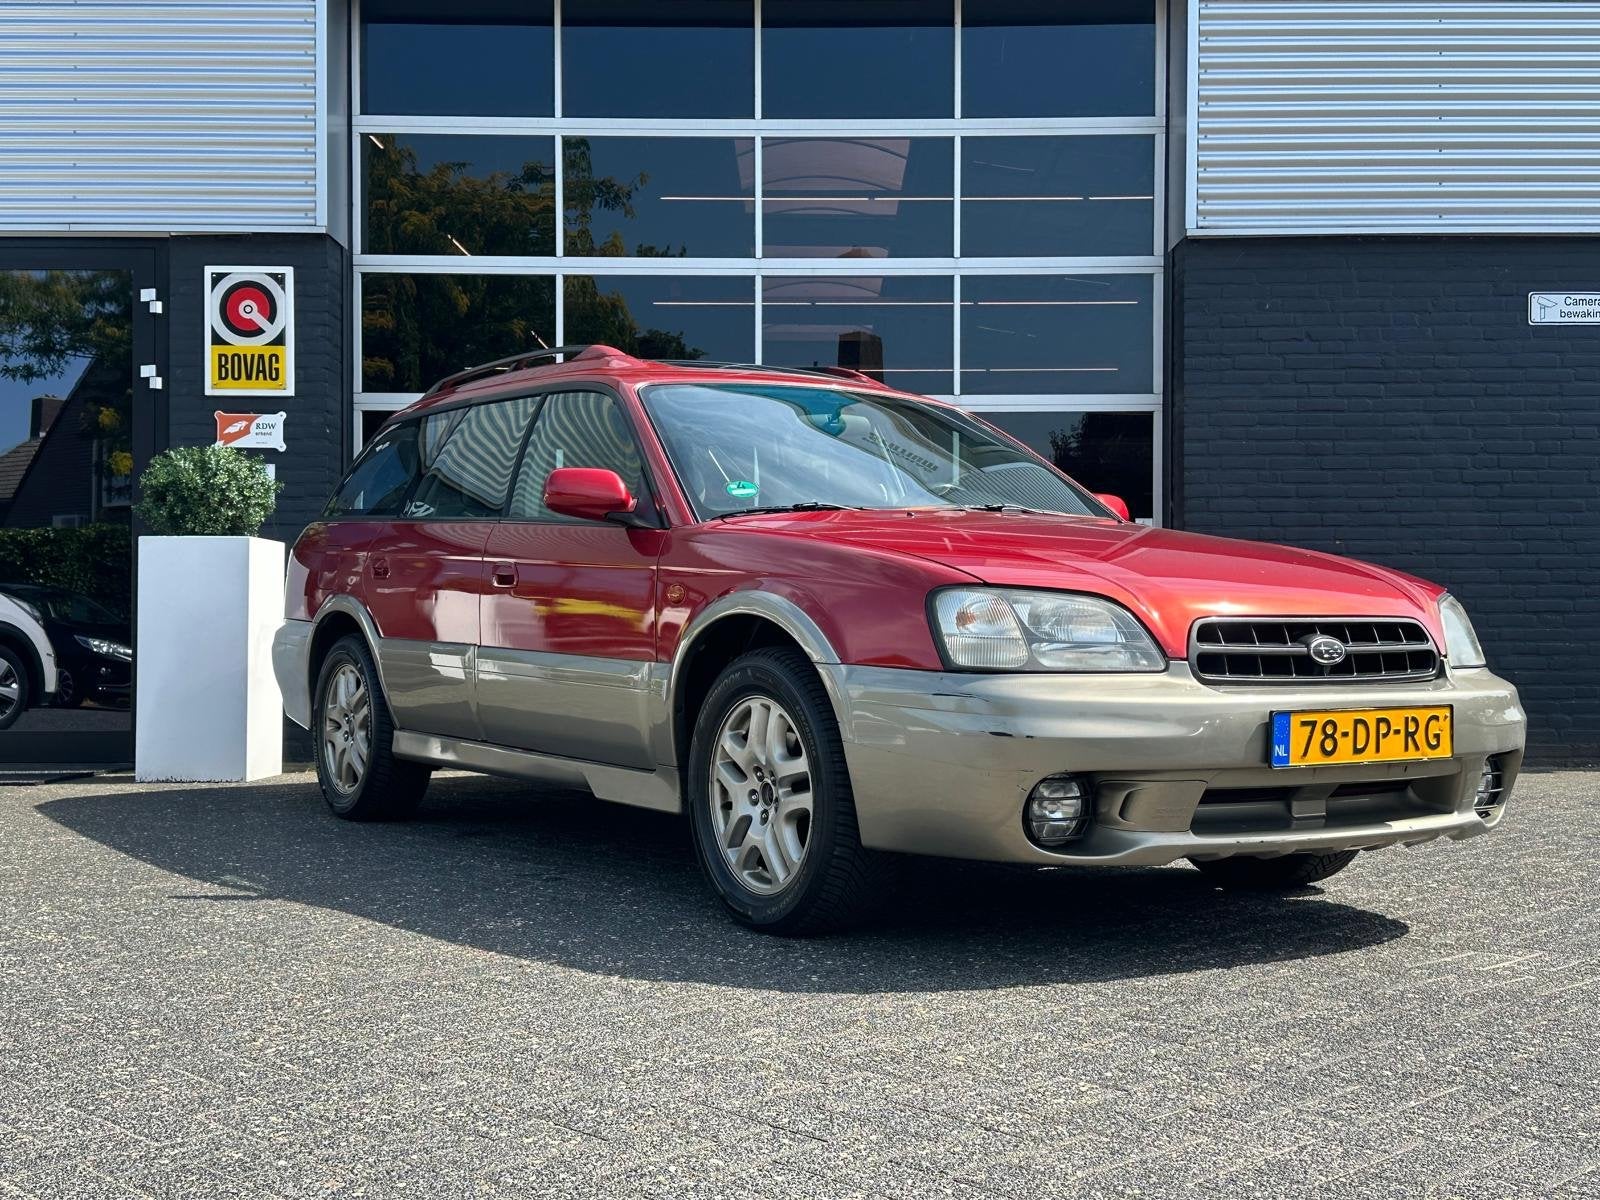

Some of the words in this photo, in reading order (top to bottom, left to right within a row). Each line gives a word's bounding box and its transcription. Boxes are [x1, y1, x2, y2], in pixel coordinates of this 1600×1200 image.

[217, 352, 280, 382] BOVAG
[255, 422, 276, 430] RDW
[1300, 714, 1442, 759] 78-DP-RG
[1274, 744, 1288, 757] NL
